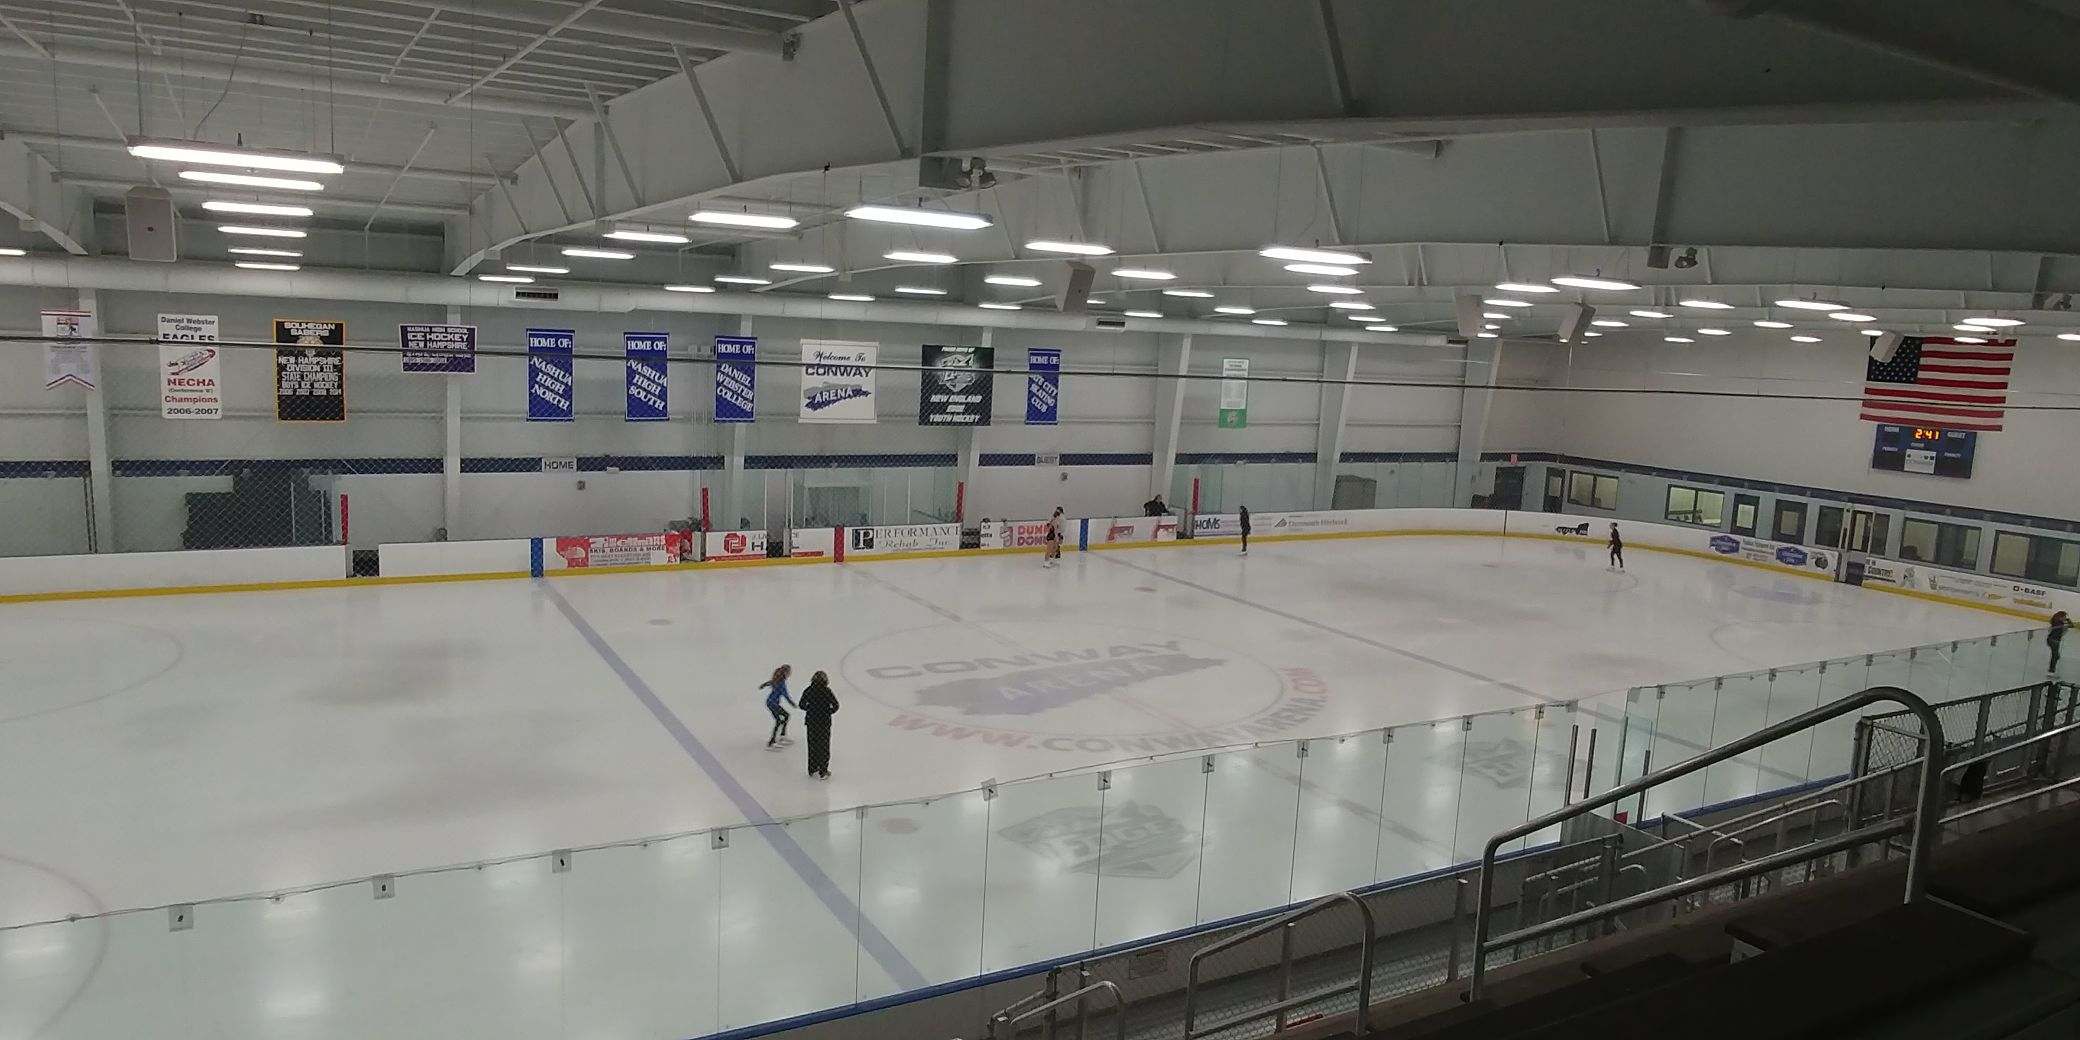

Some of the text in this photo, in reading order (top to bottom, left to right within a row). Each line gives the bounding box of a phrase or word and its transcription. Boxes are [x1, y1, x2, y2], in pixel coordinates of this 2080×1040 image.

[161, 316, 184, 324] Daniel
[426, 333, 469, 341] HOCKEY
[530, 337, 571, 348] HOME OF:
[427, 341, 468, 349] HAMPSHIRE
[627, 340, 652, 350] HOME
[718, 343, 741, 353] HOME
[279, 356, 341, 365] NEW HAMPSHIRE
[814, 351, 866, 361] Welcome To
[1030, 356, 1049, 364] HOME
[530, 356, 572, 386] NASHUA
[627, 360, 667, 387] NASHUA
[720, 363, 751, 386] DANIEL
[805, 365, 873, 377] CONWAY
[167, 378, 215, 387] NECHA
[536, 372, 566, 394] HIGH
[633, 374, 661, 395] HIGH
[717, 372, 754, 400] WEBSTER
[165, 396, 218, 404] Champions
[531, 383, 570, 410] NORTH
[629, 385, 665, 411] SOUTH
[717, 386, 754, 412] COLLEGE
[814, 386, 853, 403] ARENA
[1031, 396, 1048, 413] CLUB
[544, 461, 574, 470] HOME
[866, 640, 1182, 679] CONWAY
